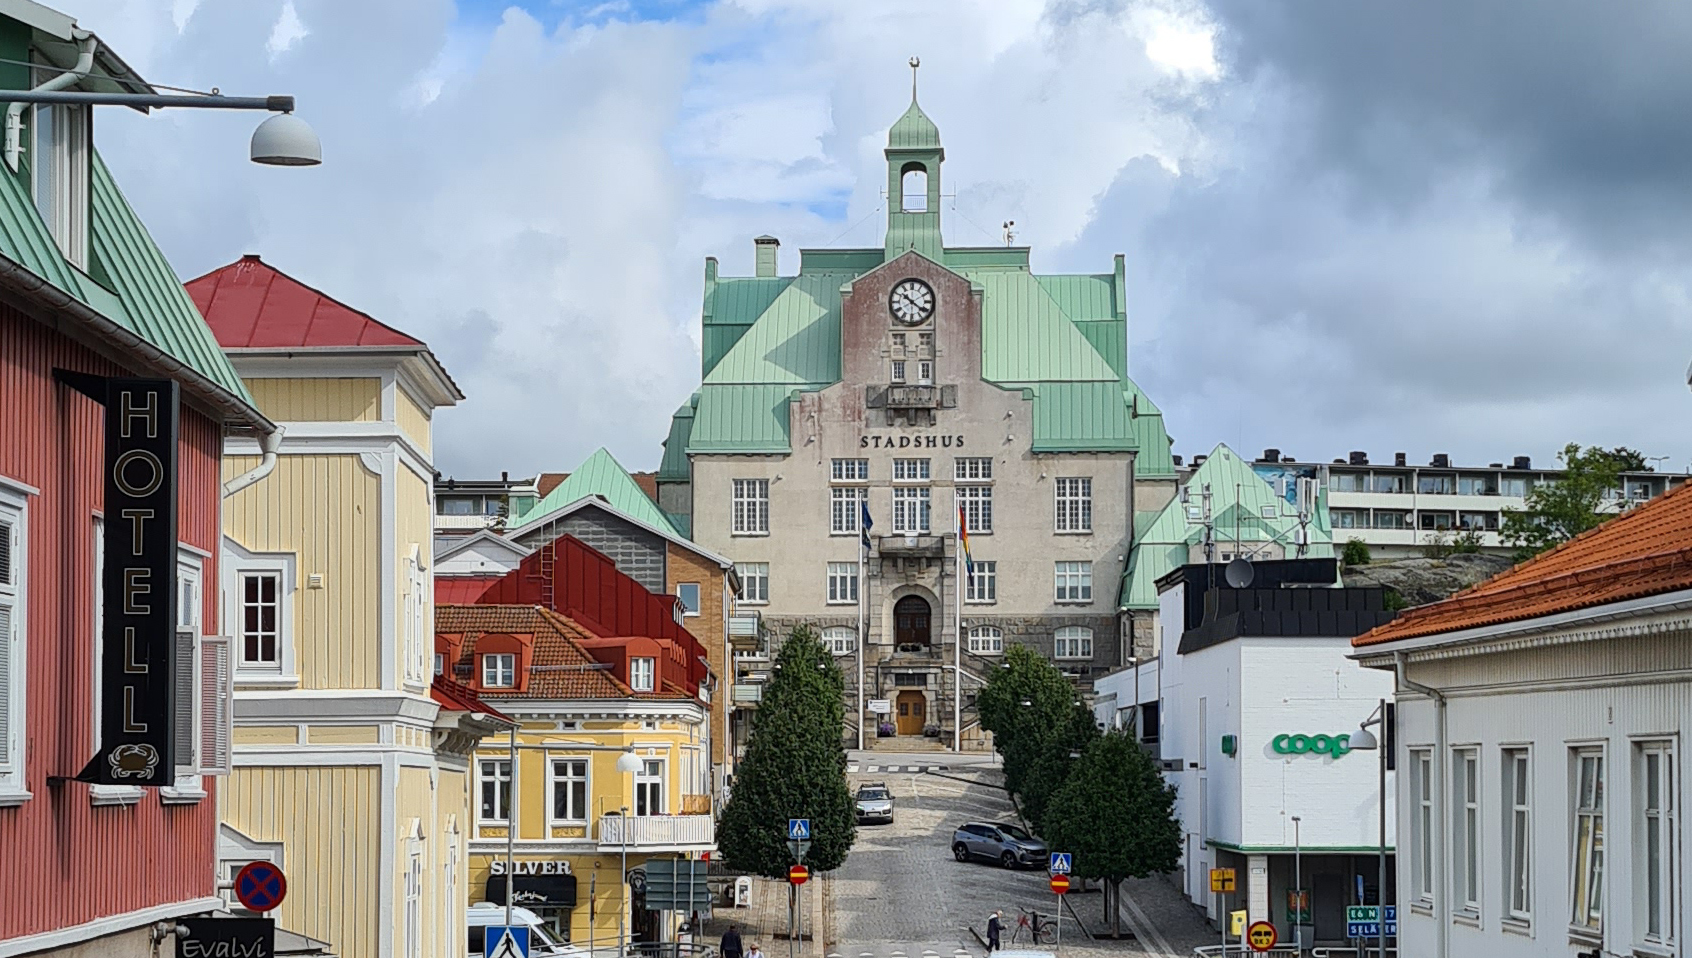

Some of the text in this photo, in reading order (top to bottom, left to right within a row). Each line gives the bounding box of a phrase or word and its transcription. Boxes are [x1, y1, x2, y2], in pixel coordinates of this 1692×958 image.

[860, 435, 964, 448] STADSHUS
[113, 391, 164, 733] HOTELL
[1272, 733, 1351, 759] coop
[1351, 909, 1376, 918] E6 N
[1350, 924, 1396, 934] SELÄER
